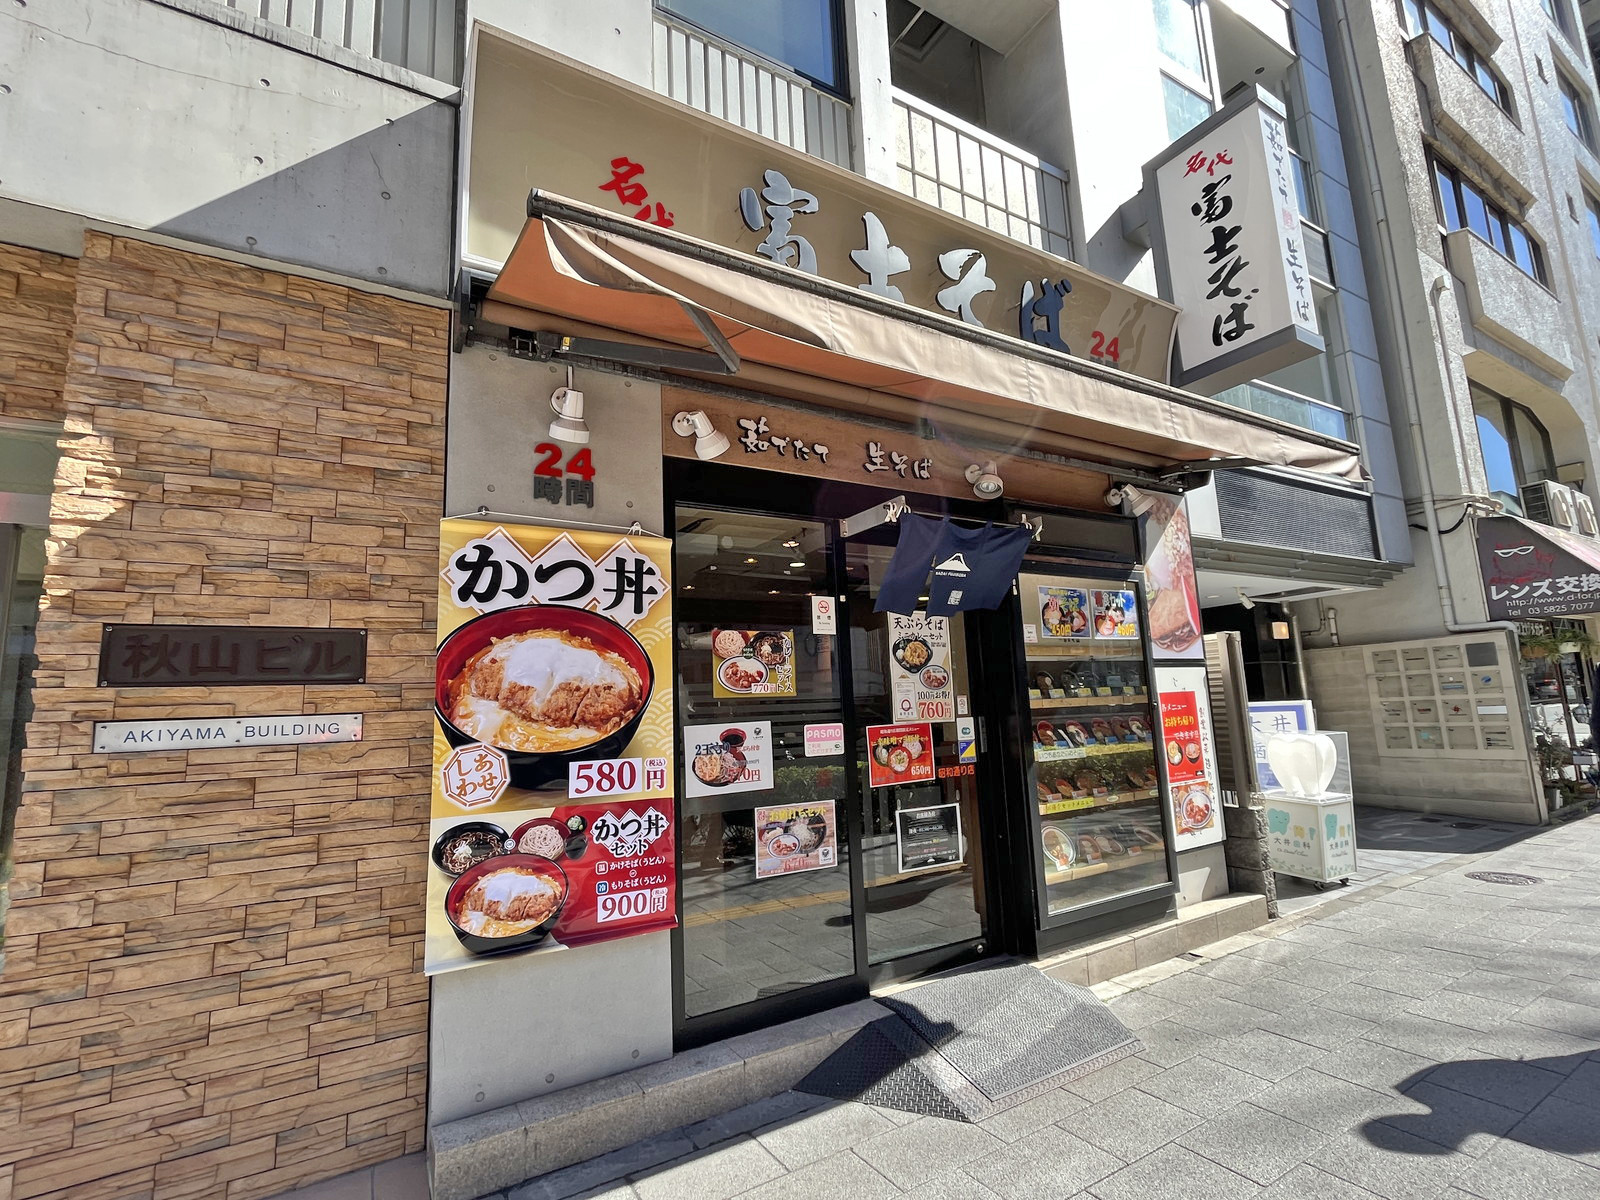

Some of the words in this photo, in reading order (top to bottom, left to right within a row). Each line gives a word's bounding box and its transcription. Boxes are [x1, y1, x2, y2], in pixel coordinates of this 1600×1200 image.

[1183, 149, 1233, 179] 名代
[1191, 174, 1260, 347] 富士そば
[1090, 330, 1119, 362] 24
[534, 442, 597, 480] 24
[736, 416, 831, 464] 茹でたて
[863, 441, 935, 481] 生そば
[533, 476, 595, 509] 時間
[454, 544, 657, 616] かつ丼
[1490, 572, 1600, 600] レンズ交換
[1508, 608, 1521, 616] Tel
[1528, 606, 1541, 615] 03
[1544, 604, 1568, 614] 5825
[1571, 602, 1594, 611] 7077
[893, 617, 944, 631] 天ぷらそば
[122, 633, 351, 679] 秋山ビル
[783, 633, 794, 693] カレーライス
[752, 683, 776, 693] 770円
[775, 665, 784, 693] セット
[919, 701, 951, 718] 760円
[1165, 715, 1194, 728] お持ち帰り
[123, 727, 226, 744] AKIYAMA
[244, 721, 341, 739] BUILDING
[806, 728, 841, 739] PASMO
[574, 761, 665, 795] 580円
[911, 766, 931, 775] 650円
[938, 765, 975, 778] 昭和通り店
[594, 814, 667, 842] かつ丼
[610, 856, 666, 870] かけそば(うどん)
[611, 843, 648, 856] セット
[611, 875, 667, 890] もりそば(うどん)
[601, 891, 666, 920] 900円
